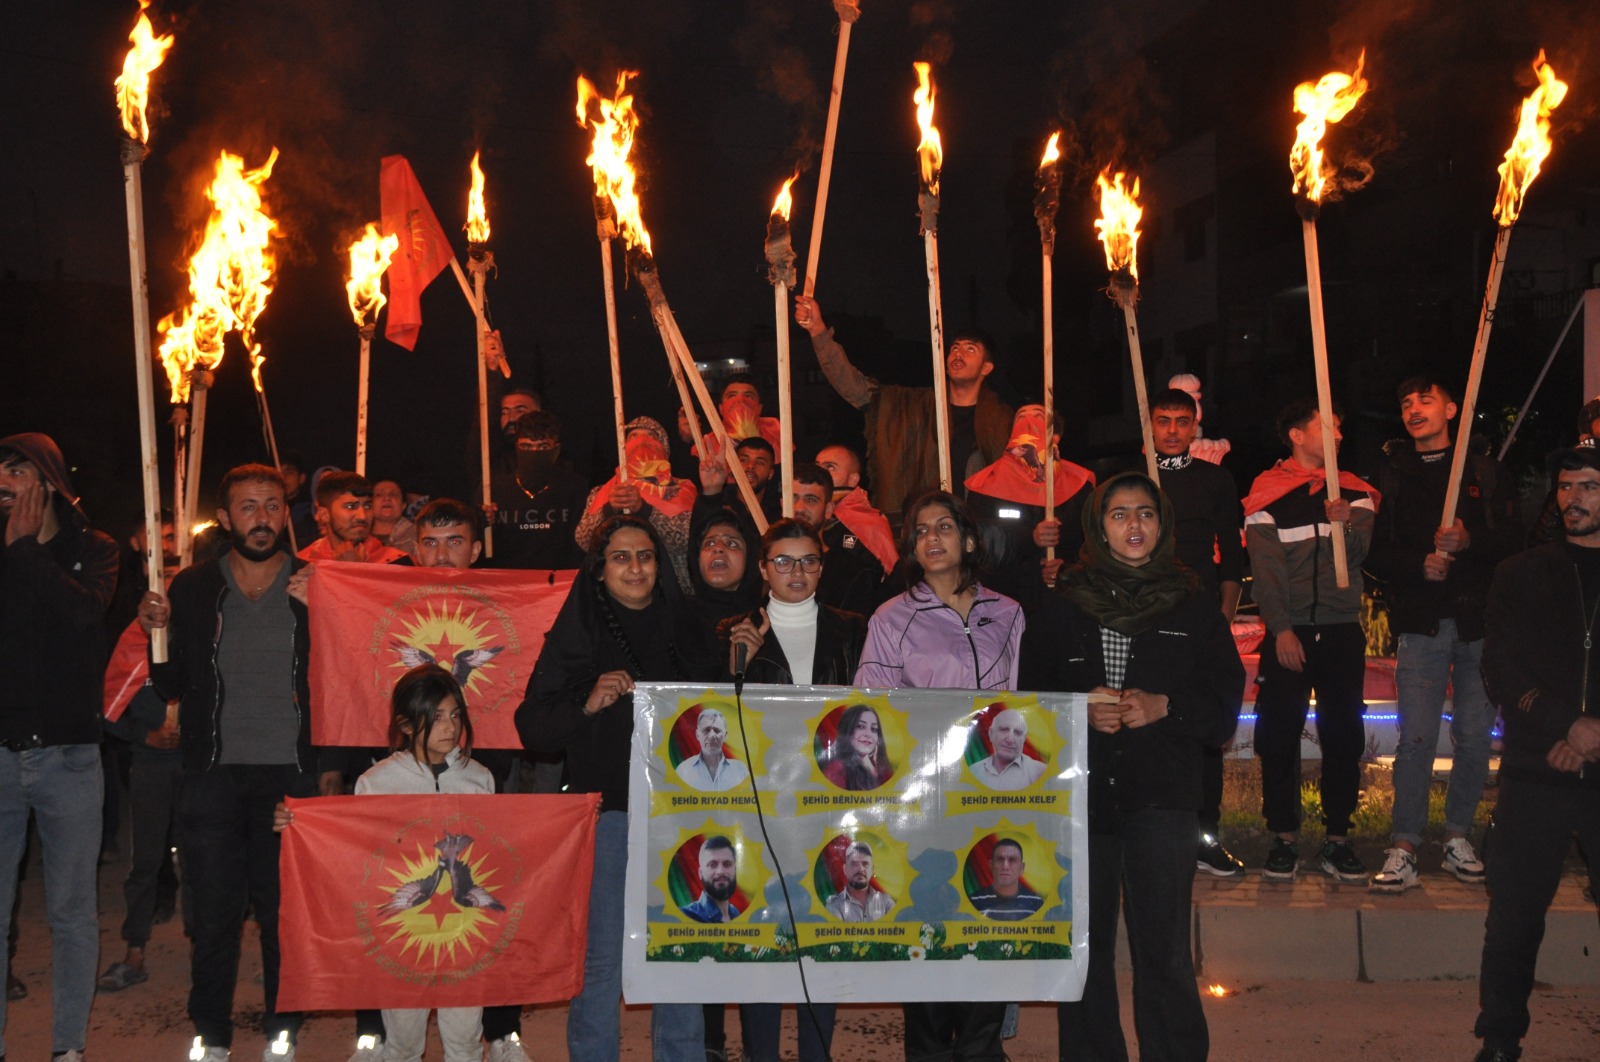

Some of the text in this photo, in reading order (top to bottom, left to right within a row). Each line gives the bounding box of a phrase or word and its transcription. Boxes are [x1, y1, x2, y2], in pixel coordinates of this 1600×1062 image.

[499, 509, 569, 524] NICCE
[701, 796, 729, 805] RIYAD
[991, 796, 1026, 804] FERHAN
[1029, 795, 1057, 804] XELEF
[728, 928, 760, 937] EHMED
[992, 926, 1029, 935] FERHAN
